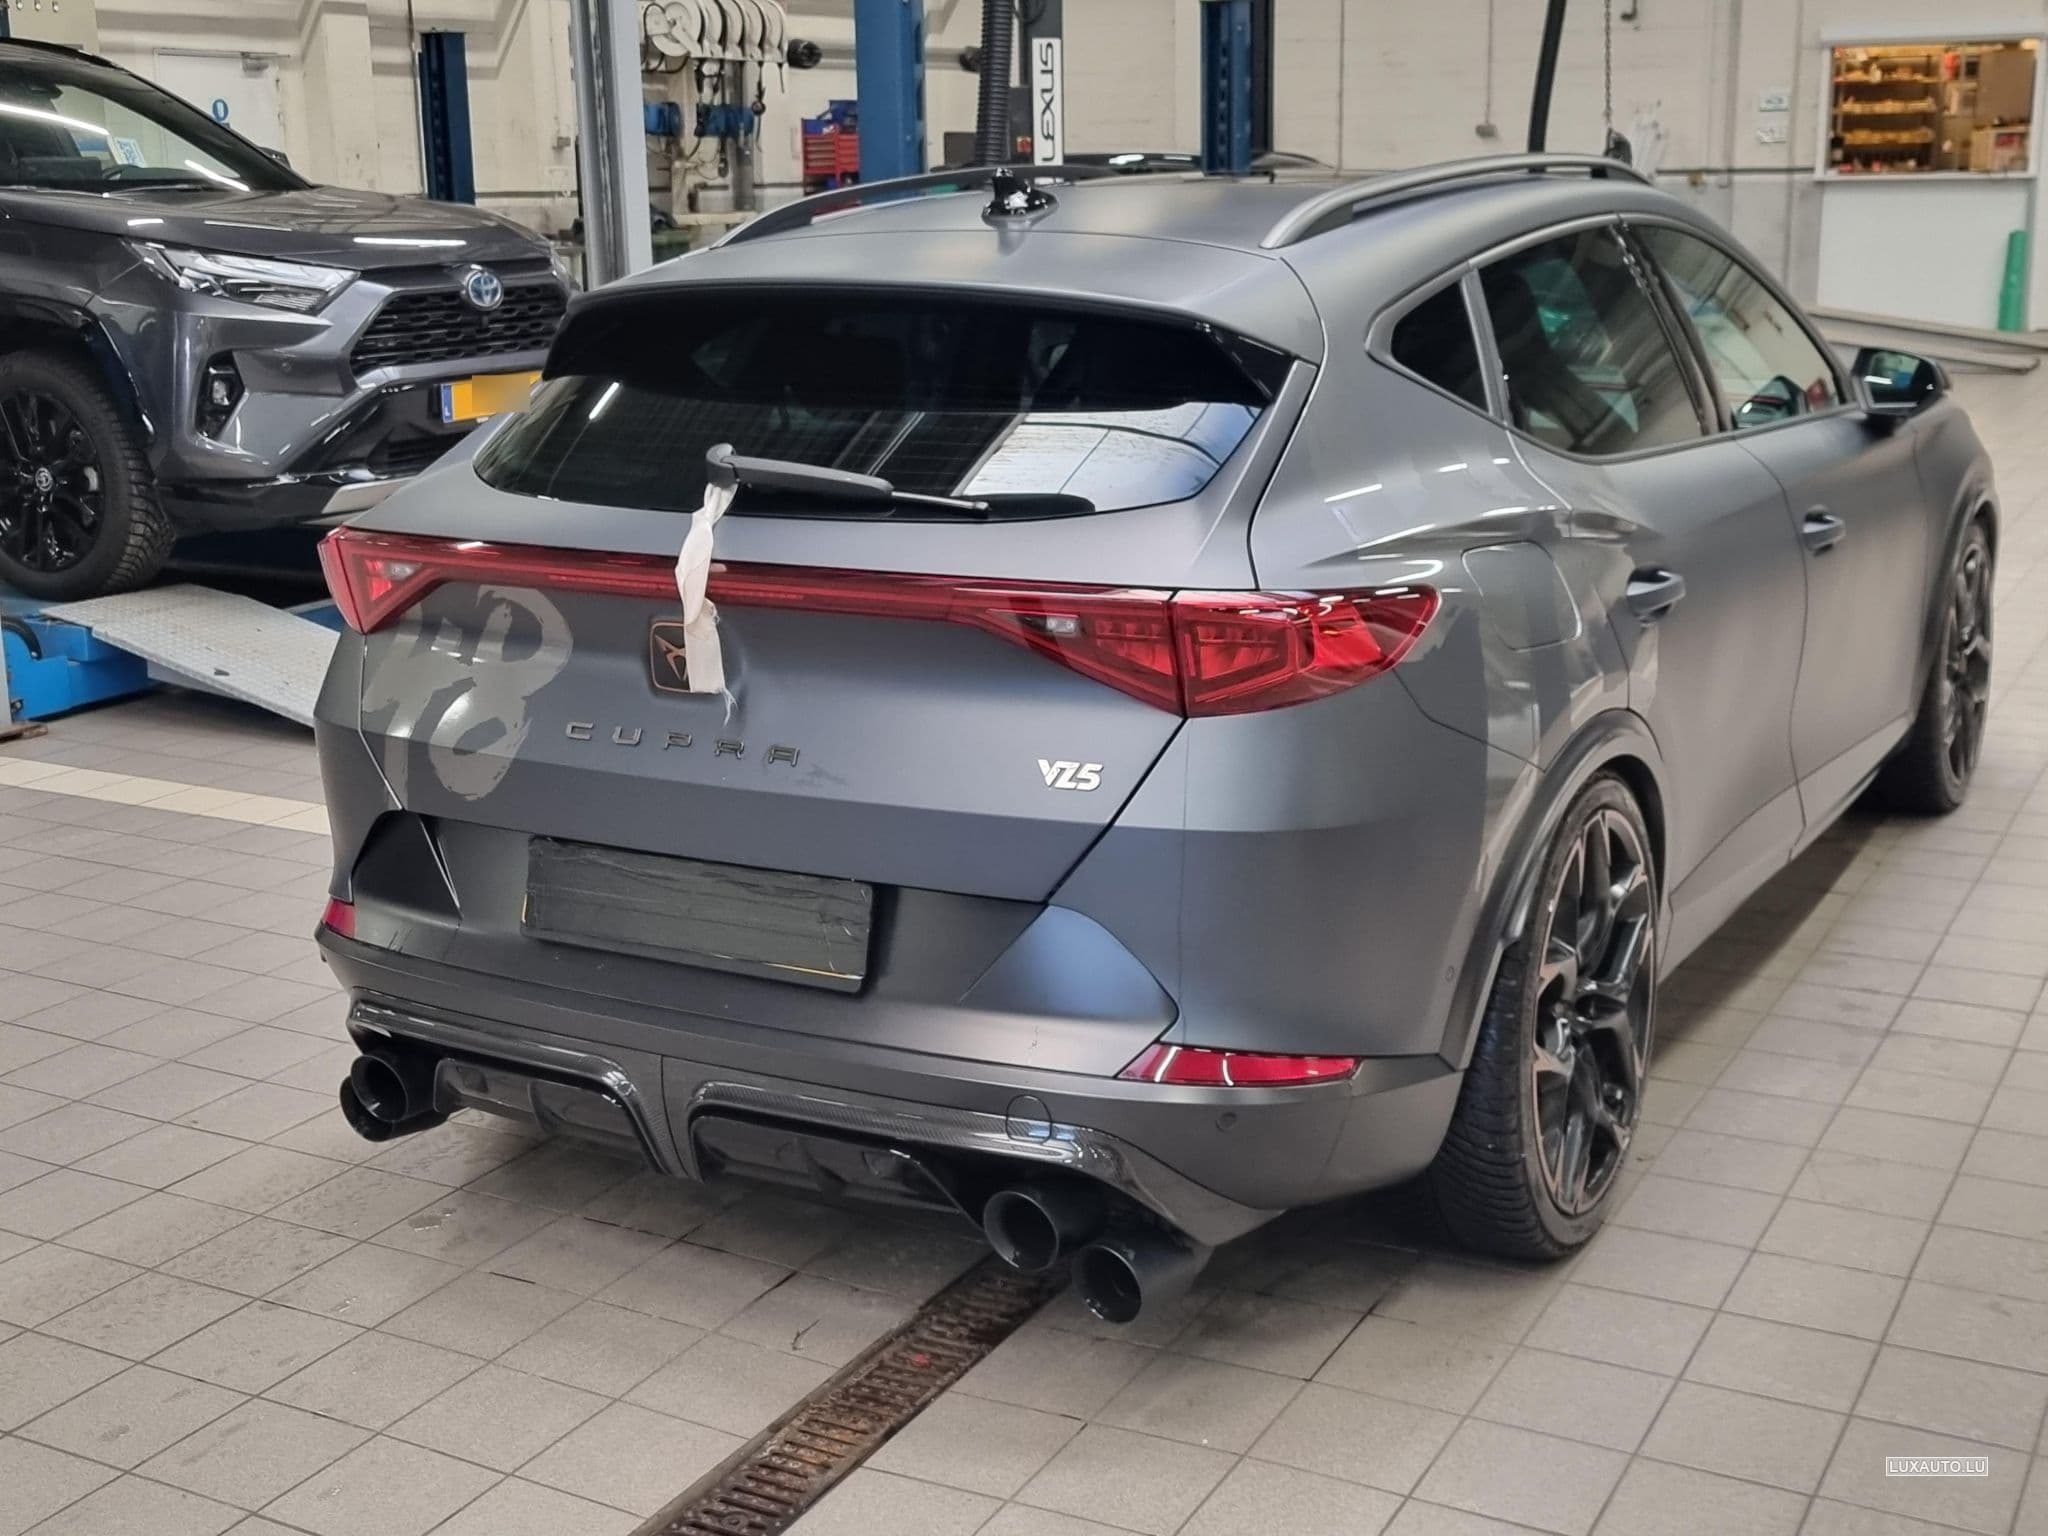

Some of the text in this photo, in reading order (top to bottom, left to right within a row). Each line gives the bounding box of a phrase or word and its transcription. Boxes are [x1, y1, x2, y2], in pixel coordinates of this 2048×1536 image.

[1039, 42, 1055, 162] LEXUS
[566, 721, 800, 767] CUPRA
[1037, 759, 1104, 792] VZ5
